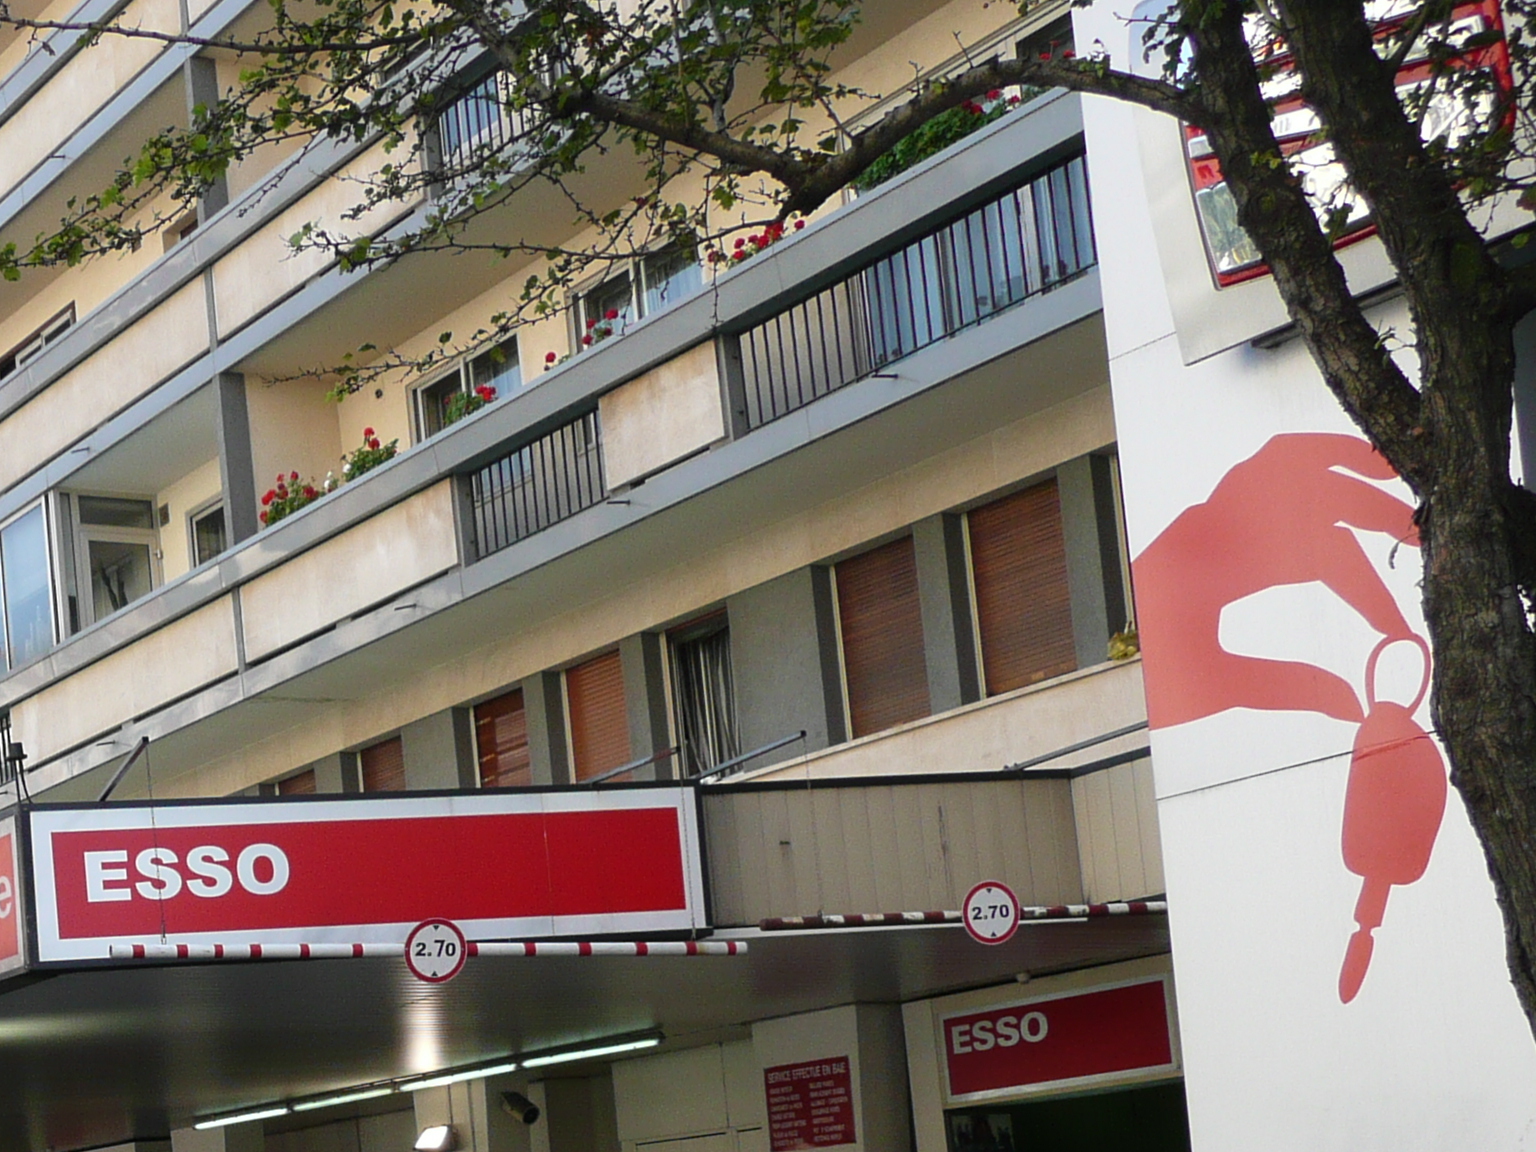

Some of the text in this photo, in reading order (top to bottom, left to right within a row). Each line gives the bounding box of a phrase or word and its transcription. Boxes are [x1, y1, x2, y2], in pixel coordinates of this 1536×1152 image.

[84, 843, 289, 902] ESSO
[972, 904, 1010, 920] 2.70
[415, 939, 456, 957] 2.70
[951, 1011, 1048, 1054] ESSO
